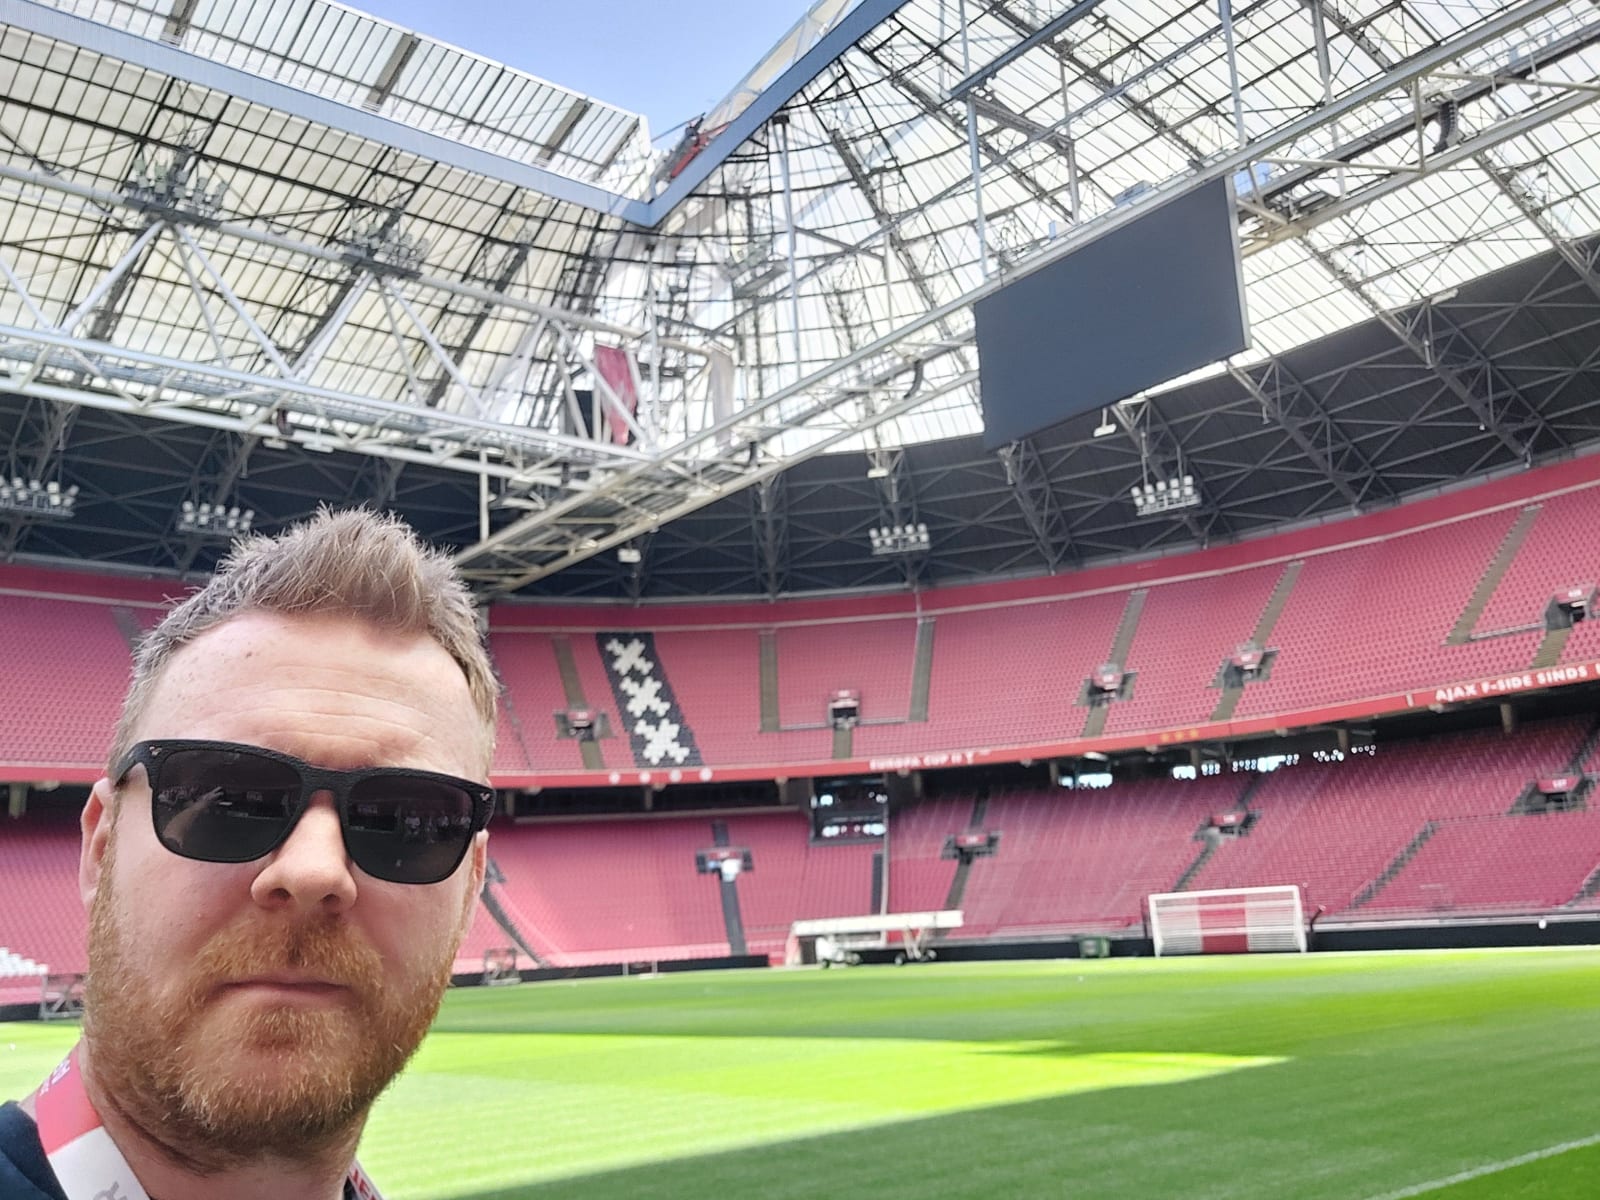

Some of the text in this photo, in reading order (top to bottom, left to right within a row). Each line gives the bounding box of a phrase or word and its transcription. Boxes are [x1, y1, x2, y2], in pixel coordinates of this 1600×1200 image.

[1435, 683, 1477, 702] AJAX
[1481, 675, 1532, 694] F-SIDE
[1536, 665, 1588, 684] SINDS
